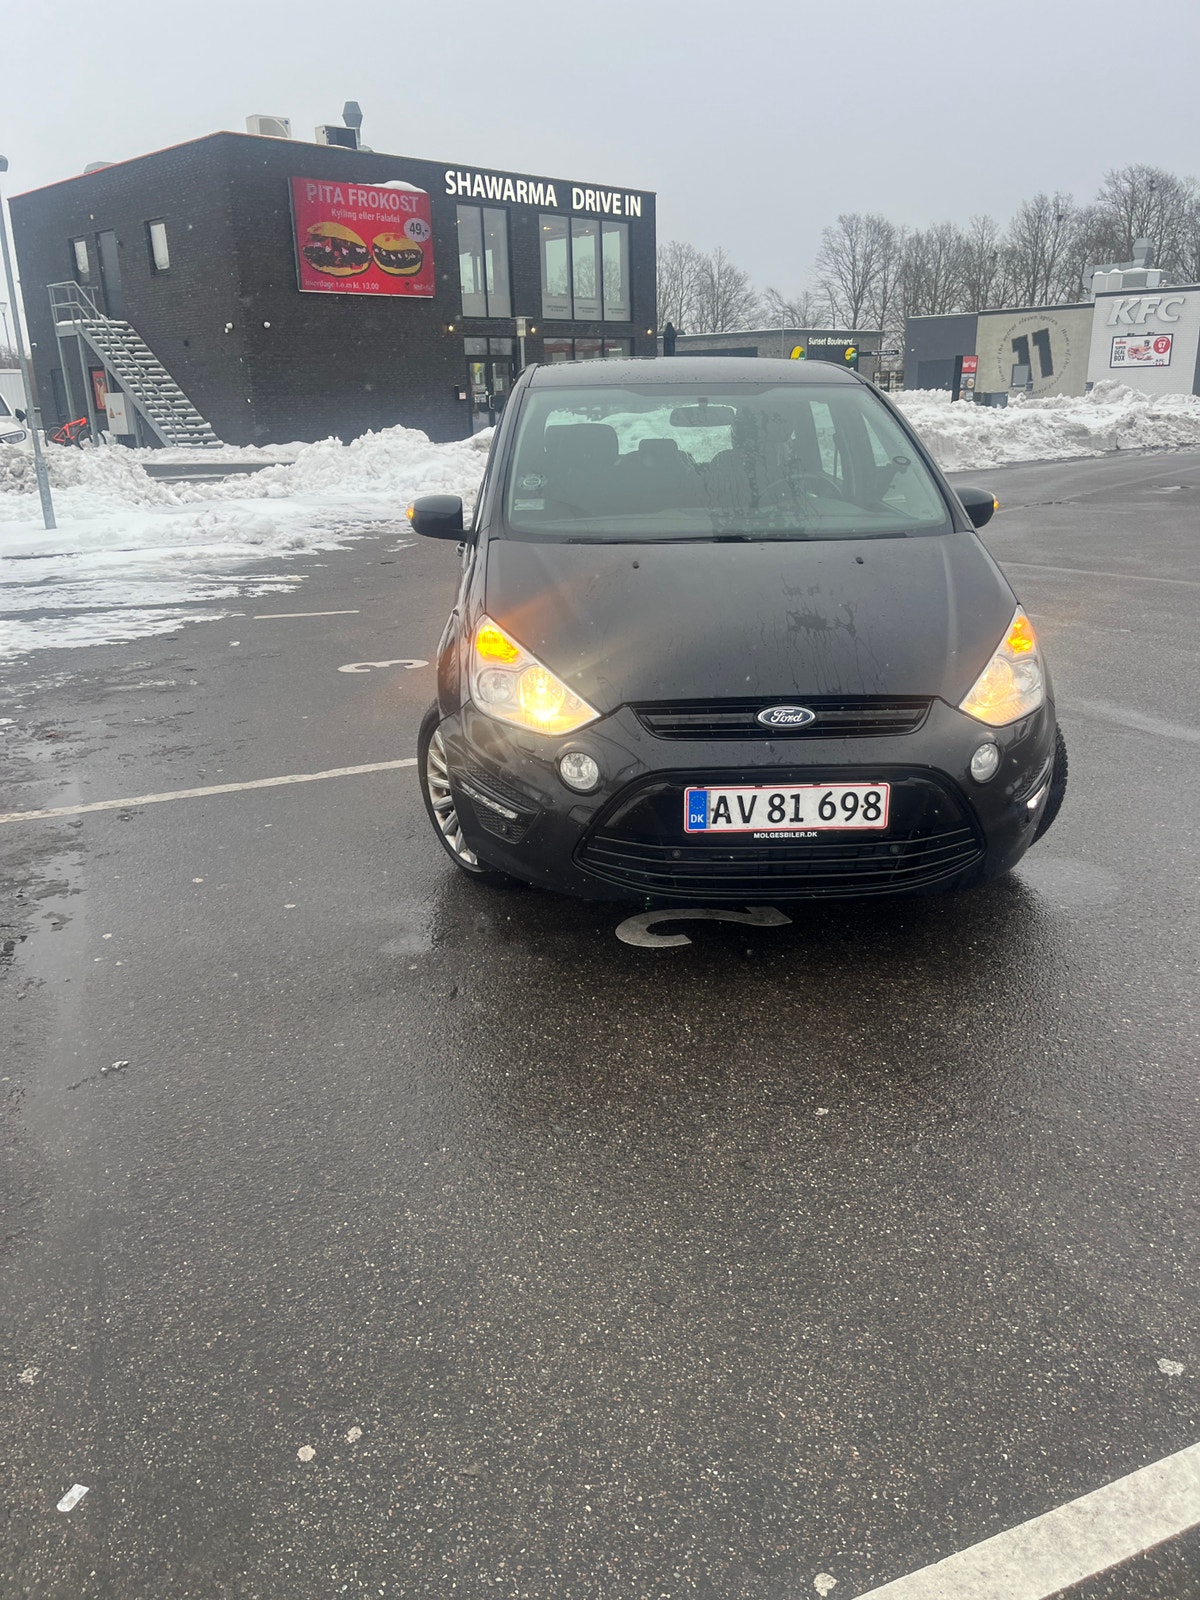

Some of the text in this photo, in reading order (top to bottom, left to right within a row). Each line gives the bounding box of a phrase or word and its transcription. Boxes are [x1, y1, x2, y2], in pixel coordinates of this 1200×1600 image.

[306, 183, 419, 212] PITA FROKOST
[444, 170, 641, 217] SHAWARMA DRIVE IN
[331, 208, 400, 223] Kylling eller Falafel
[1106, 297, 1185, 326] KFC
[808, 337, 854, 345] Sunset Boulevard
[770, 709, 804, 723] Ford
[711, 790, 882, 824] AV 81 698
[690, 814, 704, 824] DK
[753, 831, 818, 839] MOLGESBILER.DK
